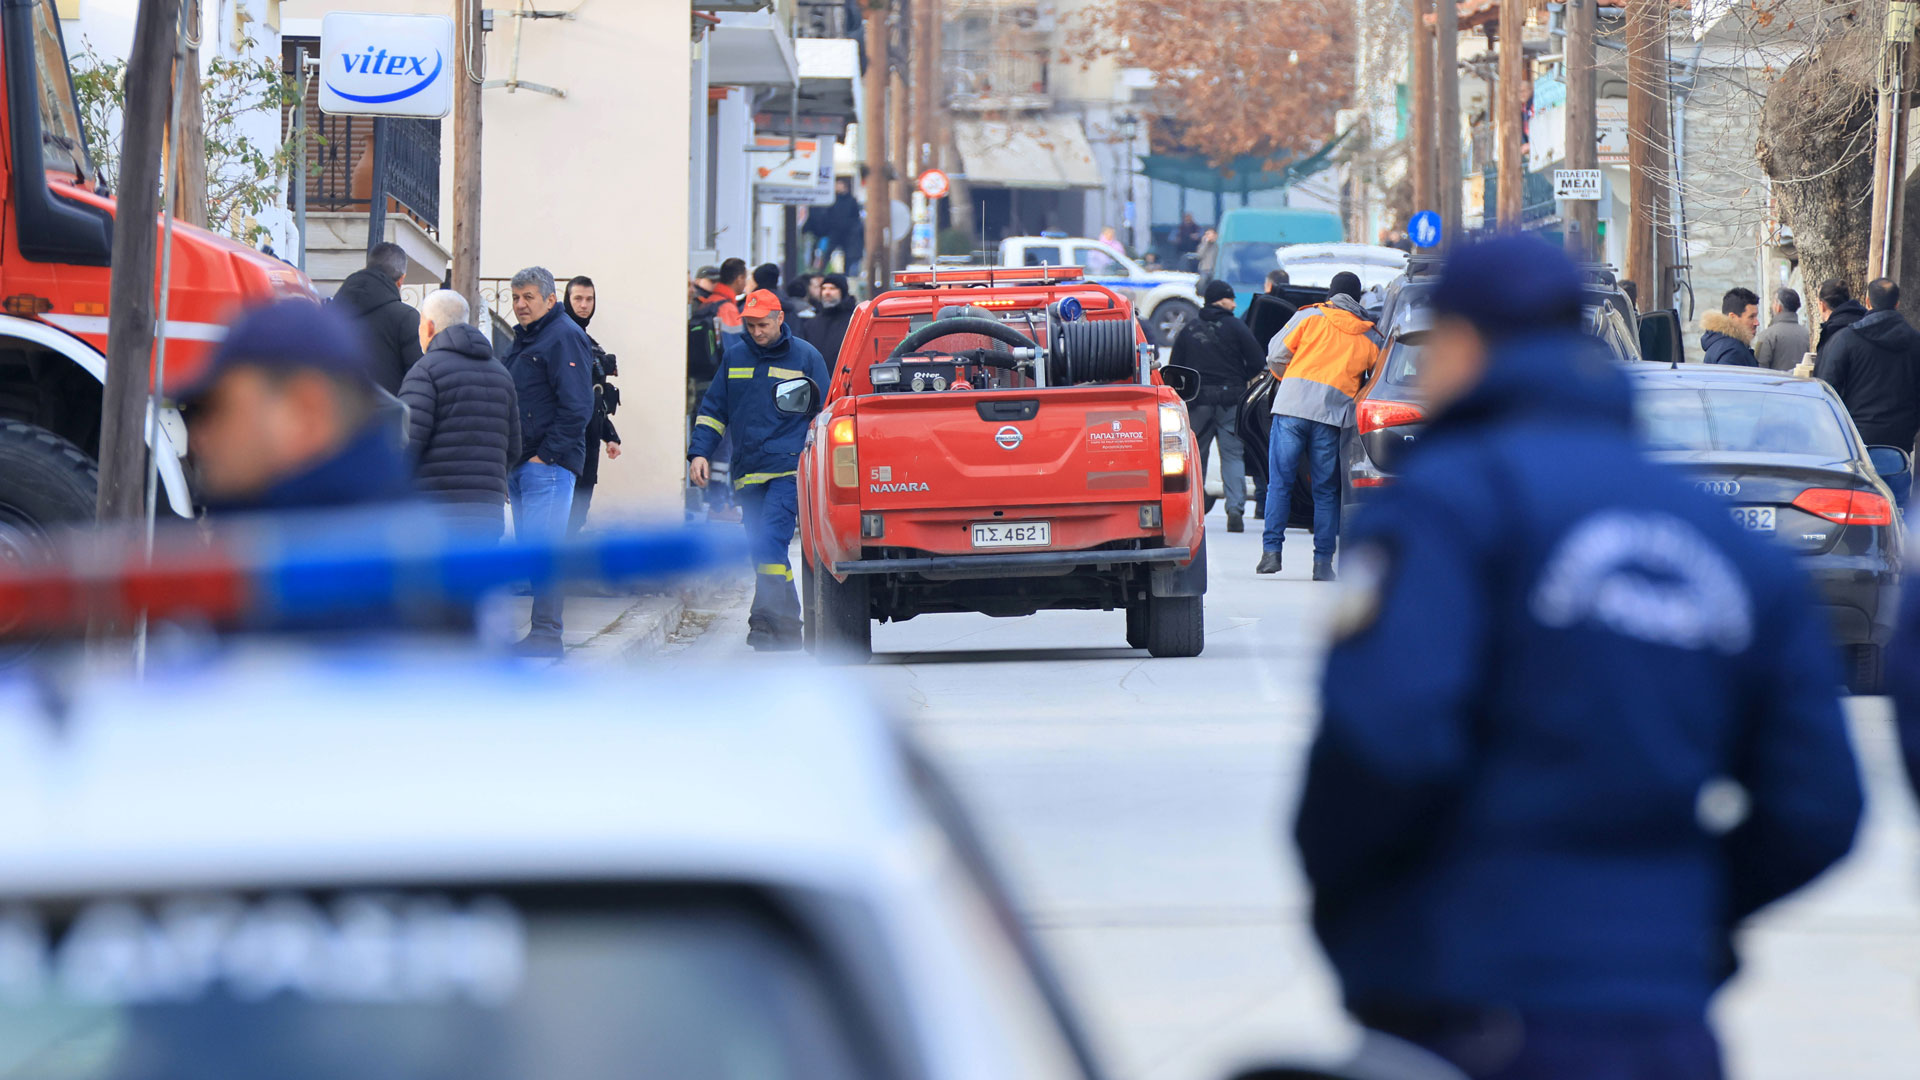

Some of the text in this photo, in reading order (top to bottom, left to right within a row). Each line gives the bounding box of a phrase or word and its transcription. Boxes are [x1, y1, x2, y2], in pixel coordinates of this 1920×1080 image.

[341, 45, 427, 76] vitex
[1561, 179, 1595, 188] ΜΕΛΙ
[1090, 432, 1143, 440] ΠΑΠΑΣΤΡΑΤΟΣ
[870, 482, 930, 493] NAVARA
